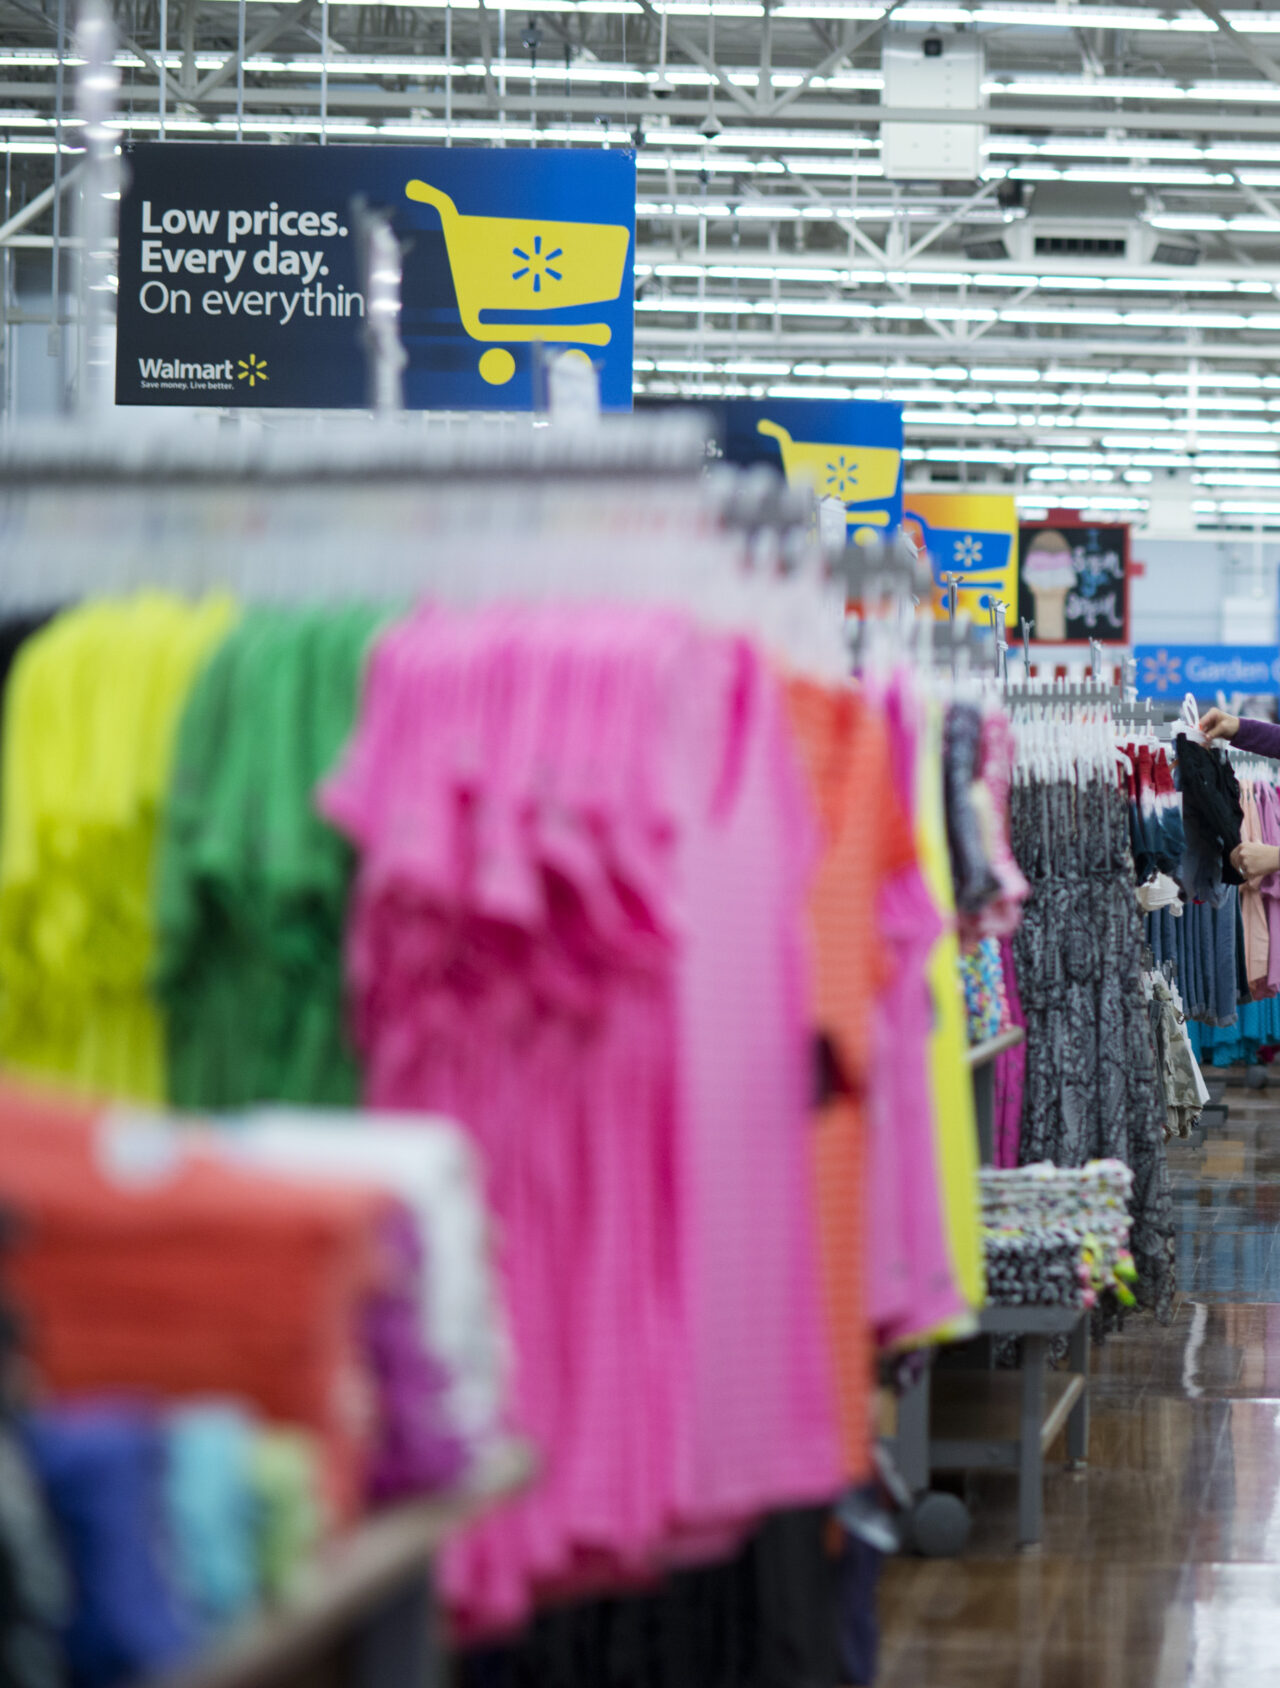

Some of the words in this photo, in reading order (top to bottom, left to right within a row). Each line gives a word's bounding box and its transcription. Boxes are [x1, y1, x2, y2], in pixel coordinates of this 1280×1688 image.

[142, 200, 220, 235] Low
[227, 201, 349, 244] prices.
[141, 239, 246, 284] Every
[253, 240, 329, 285] day.
[139, 280, 191, 314] On
[202, 282, 366, 326] everythin
[138, 358, 234, 380] Walmart
[140, 380, 160, 389] Save
[160, 381, 189, 390] money.
[190, 381, 207, 389] Live
[207, 381, 235, 390] better.
[1185, 656, 1269, 683] Garden
